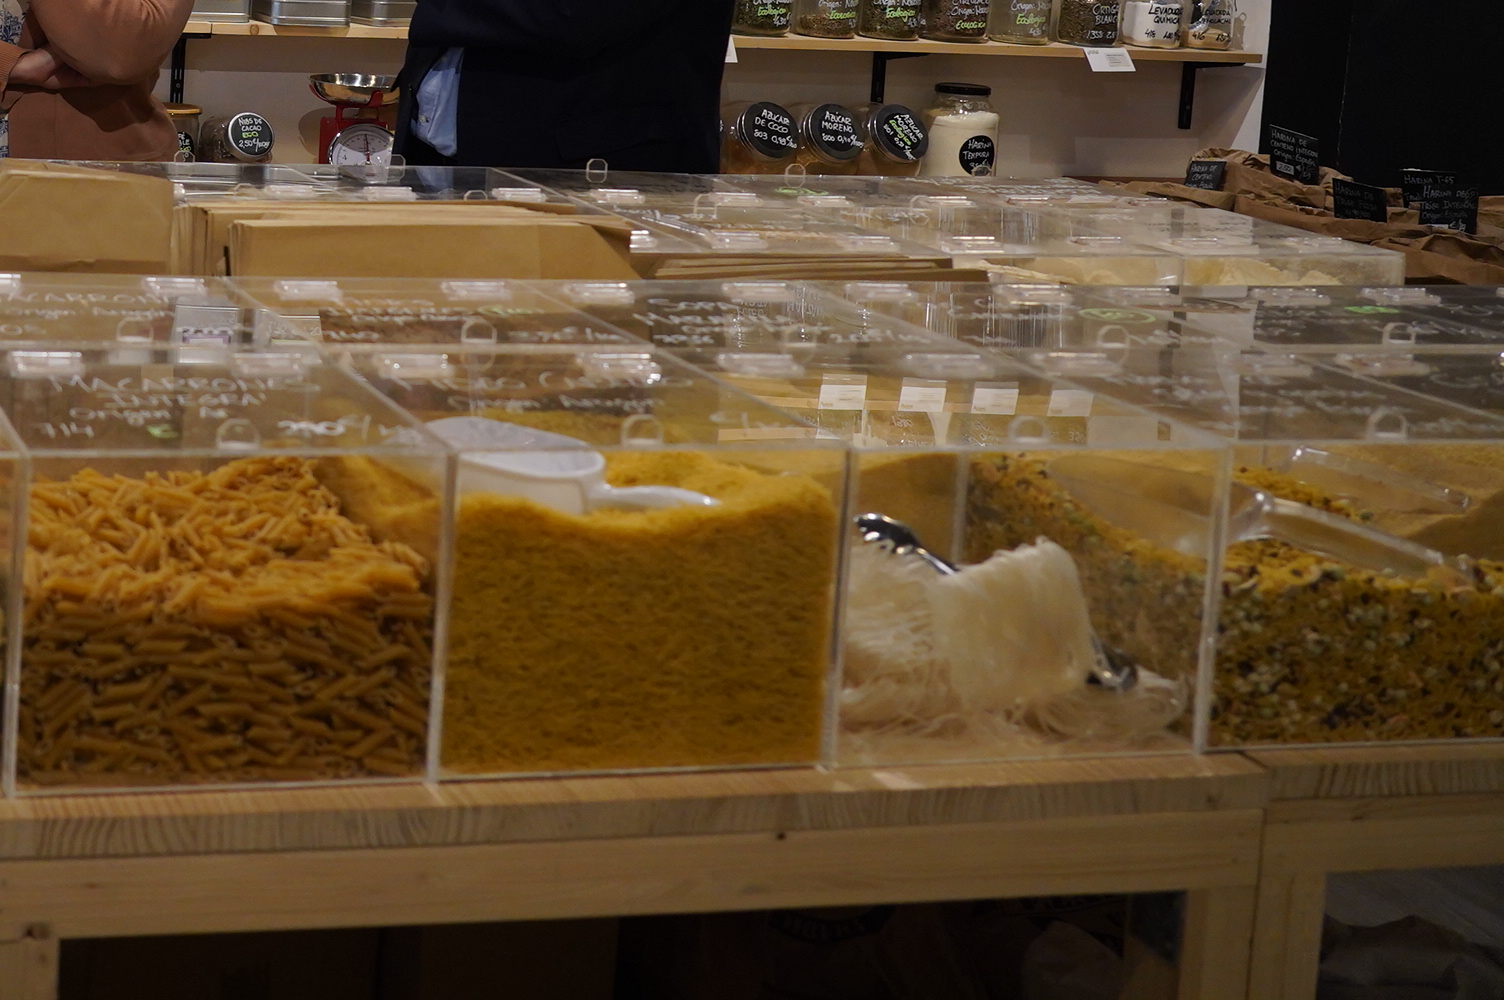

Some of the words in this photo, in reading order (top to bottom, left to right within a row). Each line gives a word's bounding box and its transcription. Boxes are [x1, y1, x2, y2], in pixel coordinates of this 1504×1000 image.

[1095, 14, 1118, 26] BLANC
[754, 116, 766, 127] DE
[767, 121, 789, 133] COCO
[821, 120, 853, 133] MORENO
[893, 115, 918, 143] MORENO
[1270, 129, 1294, 145] HARINA
[1299, 138, 1307, 147] DE
[1270, 140, 1294, 153] CENTENO
[1403, 174, 1433, 185] HARINA
[1423, 185, 1452, 198] HARINA
